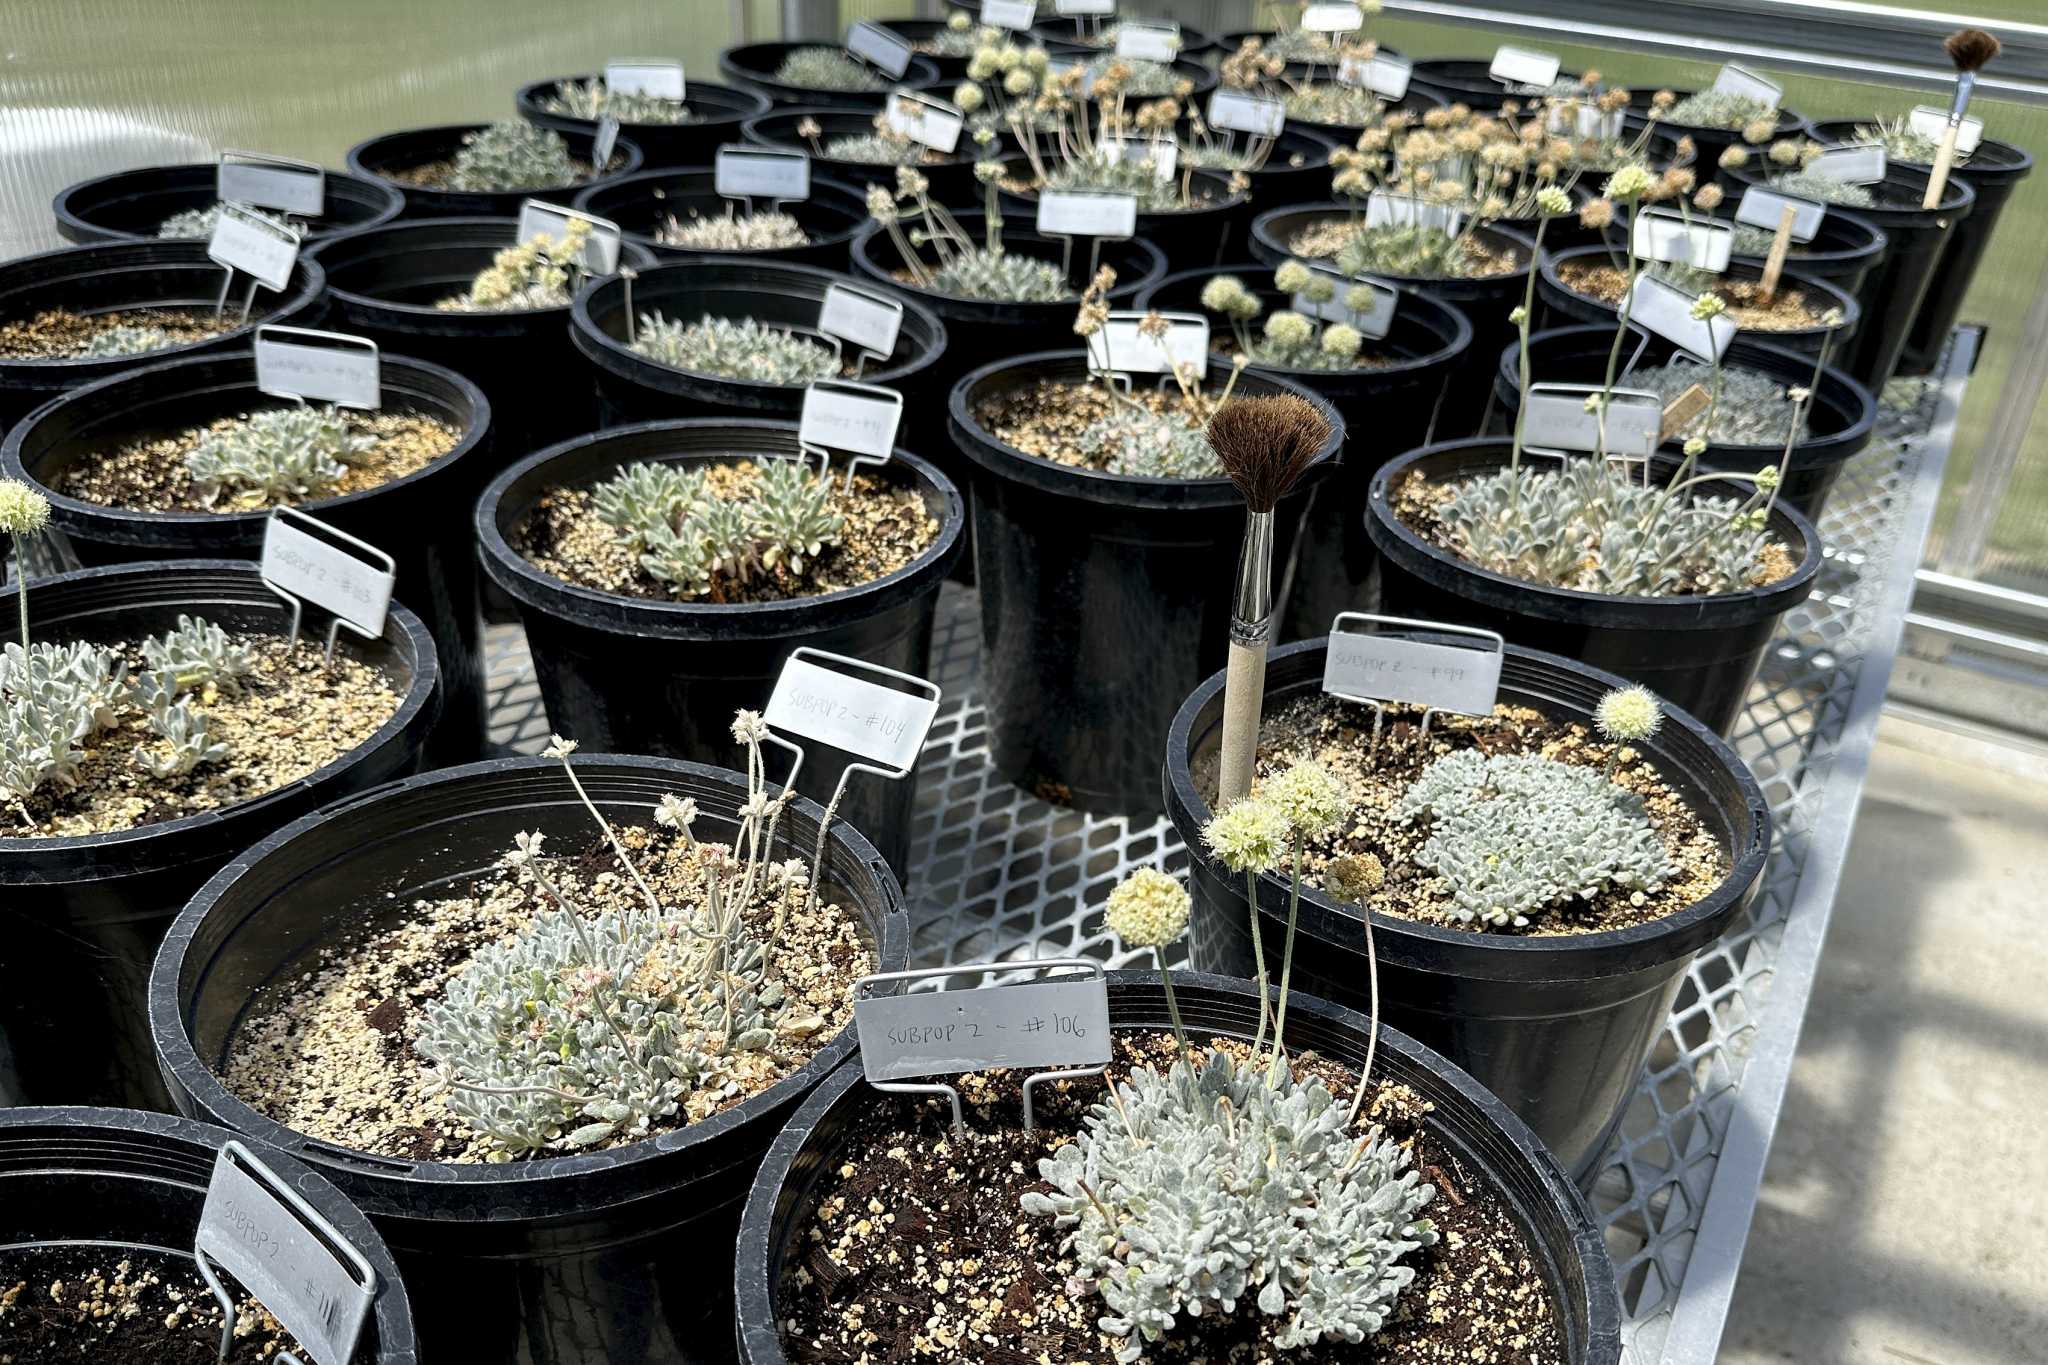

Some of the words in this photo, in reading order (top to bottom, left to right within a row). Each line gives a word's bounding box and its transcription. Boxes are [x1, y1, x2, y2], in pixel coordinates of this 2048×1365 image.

[838, 705, 848, 721] 2
[887, 1023, 957, 1046] SUBPOP
[964, 1023, 985, 1037] 2
